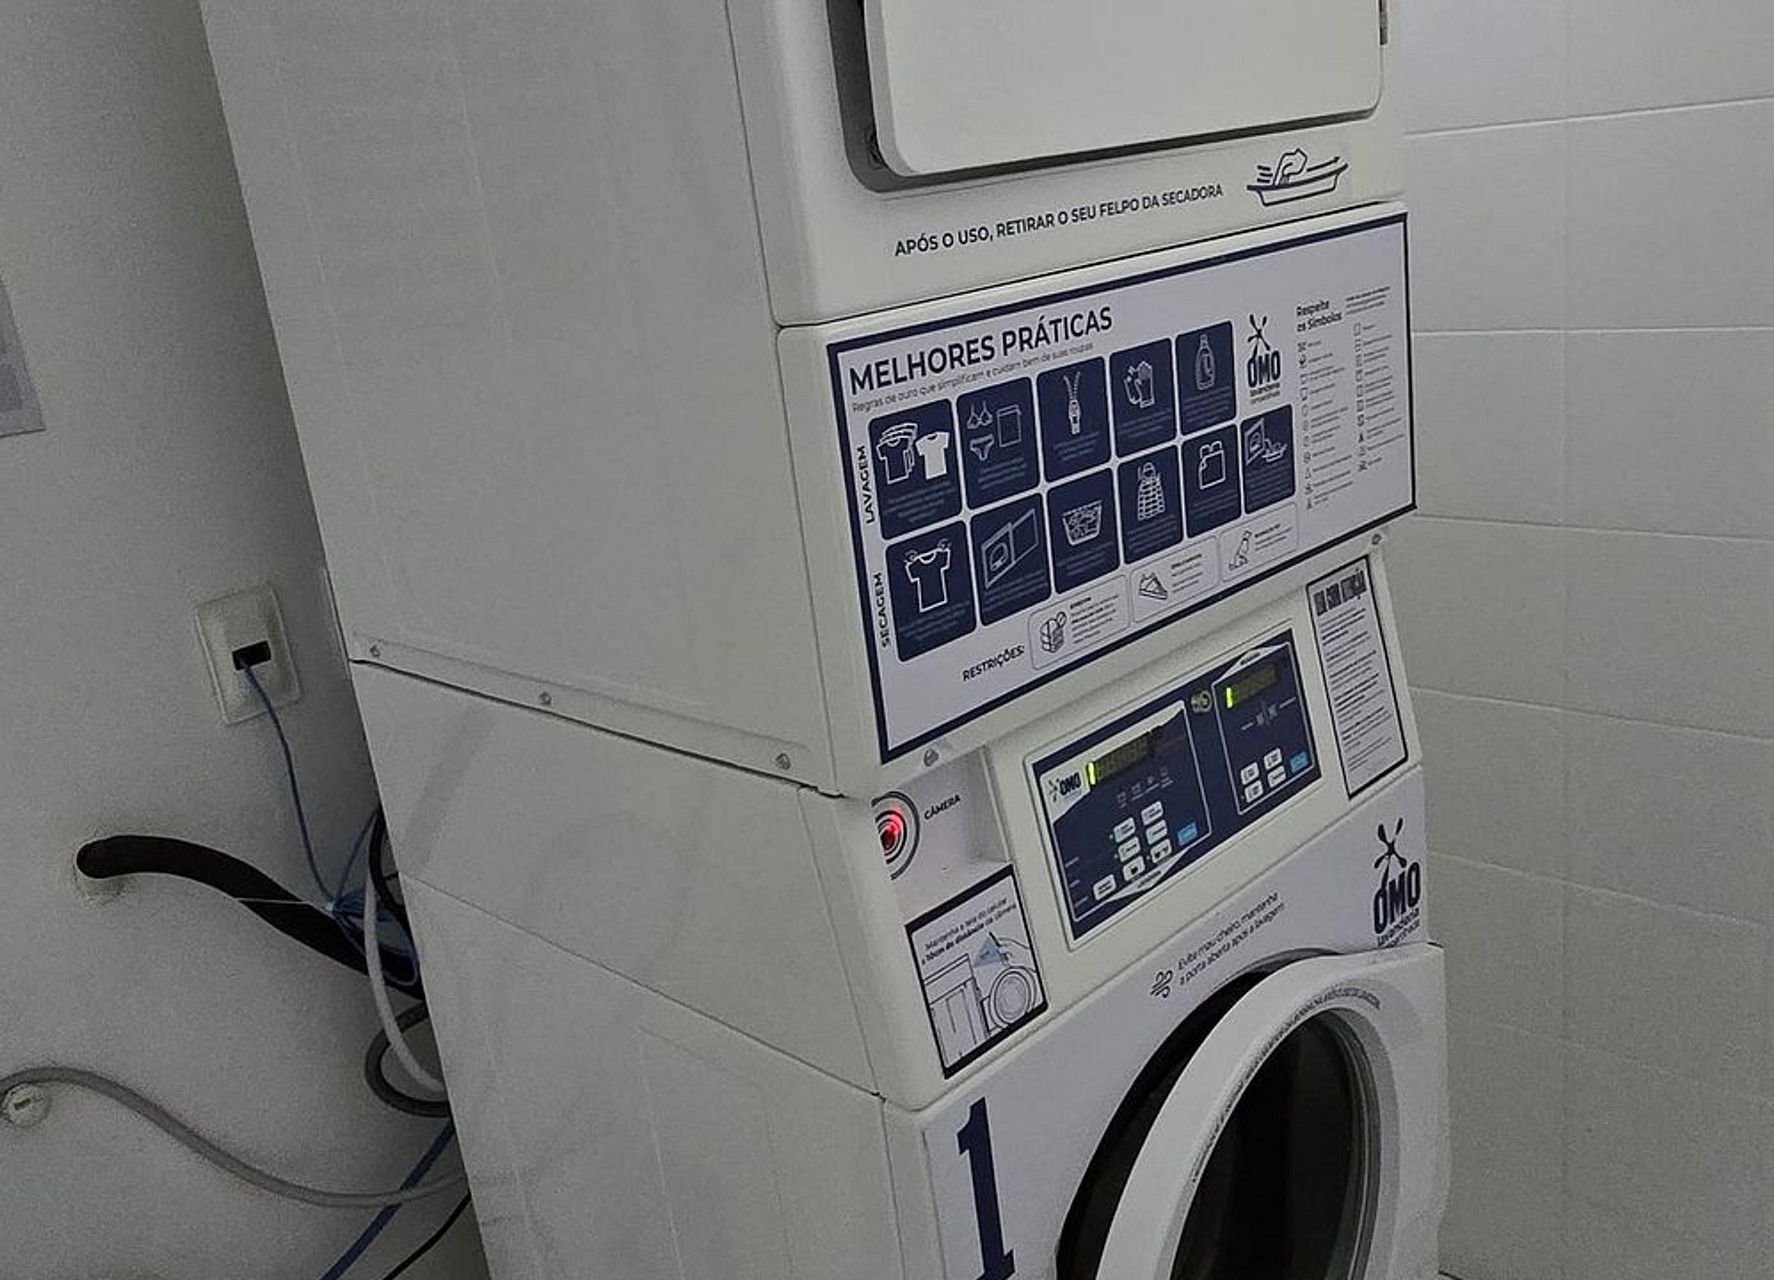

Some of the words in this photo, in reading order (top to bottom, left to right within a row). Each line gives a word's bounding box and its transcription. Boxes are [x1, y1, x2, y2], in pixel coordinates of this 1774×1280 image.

[894, 232, 938, 257] APÓS
[942, 233, 954, 248] O
[958, 227, 993, 245] USO,
[996, 213, 1055, 238] RETIRAR
[1057, 211, 1068, 225] O
[1072, 206, 1096, 222] SEU
[1100, 198, 1139, 218] FELPO
[1142, 195, 1159, 209] DA
[1162, 184, 1223, 206] SECADORA
[850, 335, 995, 395] MELHORES
[1002, 307, 1112, 356] PRÁTICAS
[852, 395, 884, 413] Regras
[885, 394, 896, 406] de
[898, 389, 918, 401] ouro
[919, 384, 936, 398] que
[938, 370, 985, 391] simplificam
[992, 360, 1021, 376] cuidam
[1023, 356, 1040, 369] bem
[1041, 352, 1051, 363] de
[1247, 350, 1281, 388] OMO
[857, 445, 875, 524] LAVAGEM
[874, 572, 891, 648] SECAGEM
[962, 644, 1025, 682] RESTRIÇÕES:
[924, 794, 961, 820] CÂMERA
[1060, 772, 1082, 796] OMO
[1374, 862, 1421, 935] OMO
